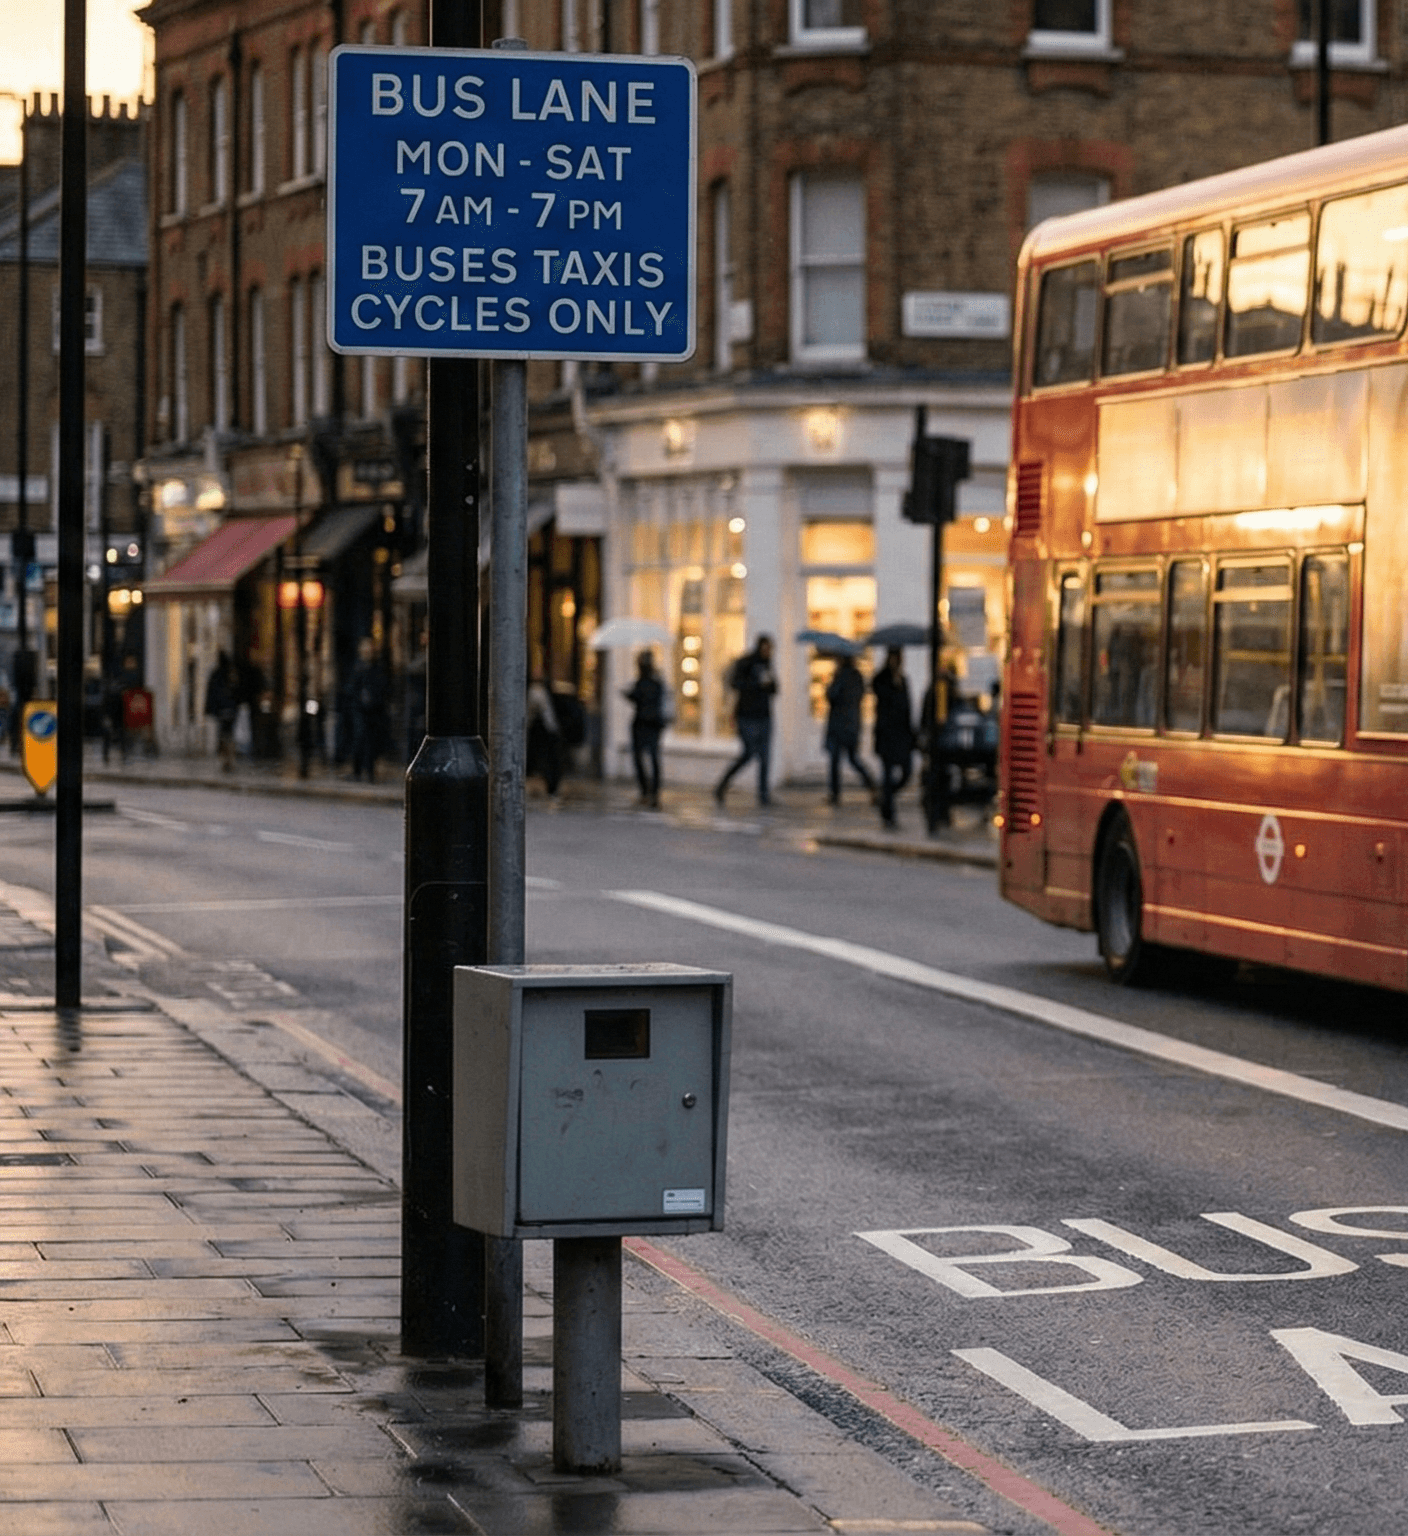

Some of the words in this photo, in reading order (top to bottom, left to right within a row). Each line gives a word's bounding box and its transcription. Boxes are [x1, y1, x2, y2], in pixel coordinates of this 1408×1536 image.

[372, 73, 486, 119] BUS
[511, 77, 656, 124] LANE
[396, 140, 505, 177] MON
[519, 159, 532, 167] -
[546, 144, 632, 181] SAT
[361, 245, 517, 284] BUSES
[533, 249, 665, 288] TAXIS
[351, 293, 531, 333] CYCLES
[548, 298, 673, 336] ONLY
